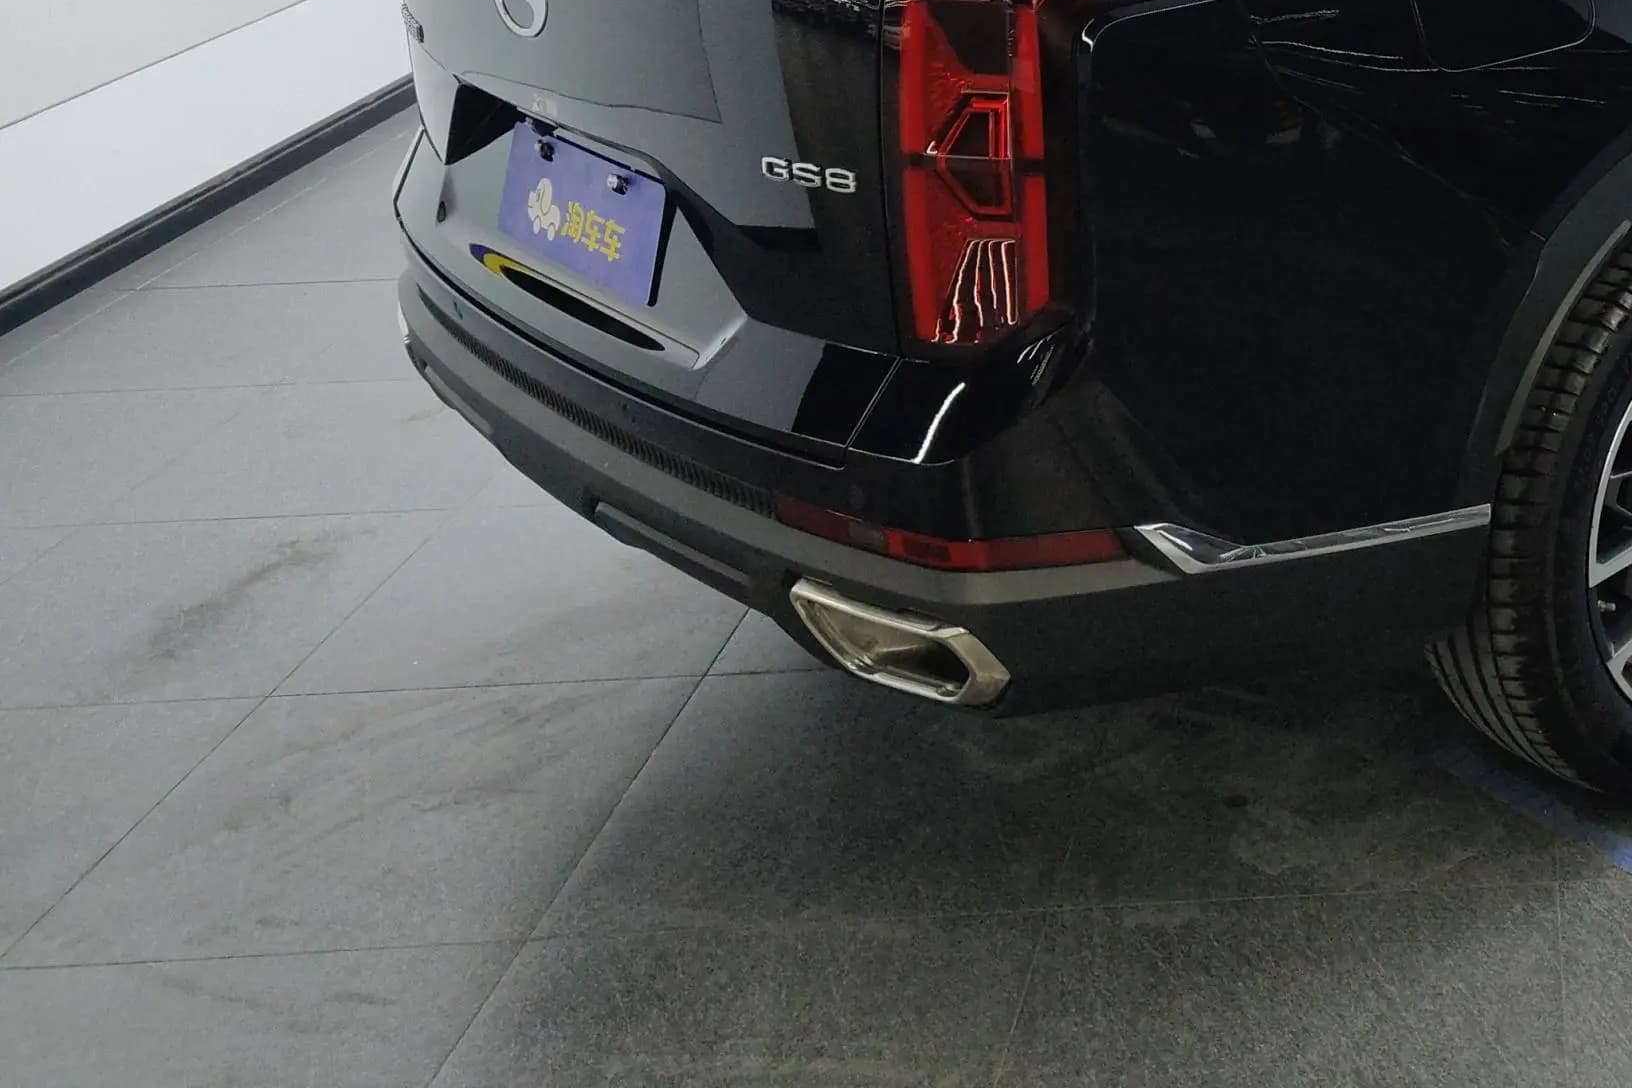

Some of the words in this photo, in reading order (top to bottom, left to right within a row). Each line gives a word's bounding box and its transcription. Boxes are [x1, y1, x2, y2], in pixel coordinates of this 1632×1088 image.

[761, 156, 857, 194] GS8
[560, 200, 625, 262] 淘车车
